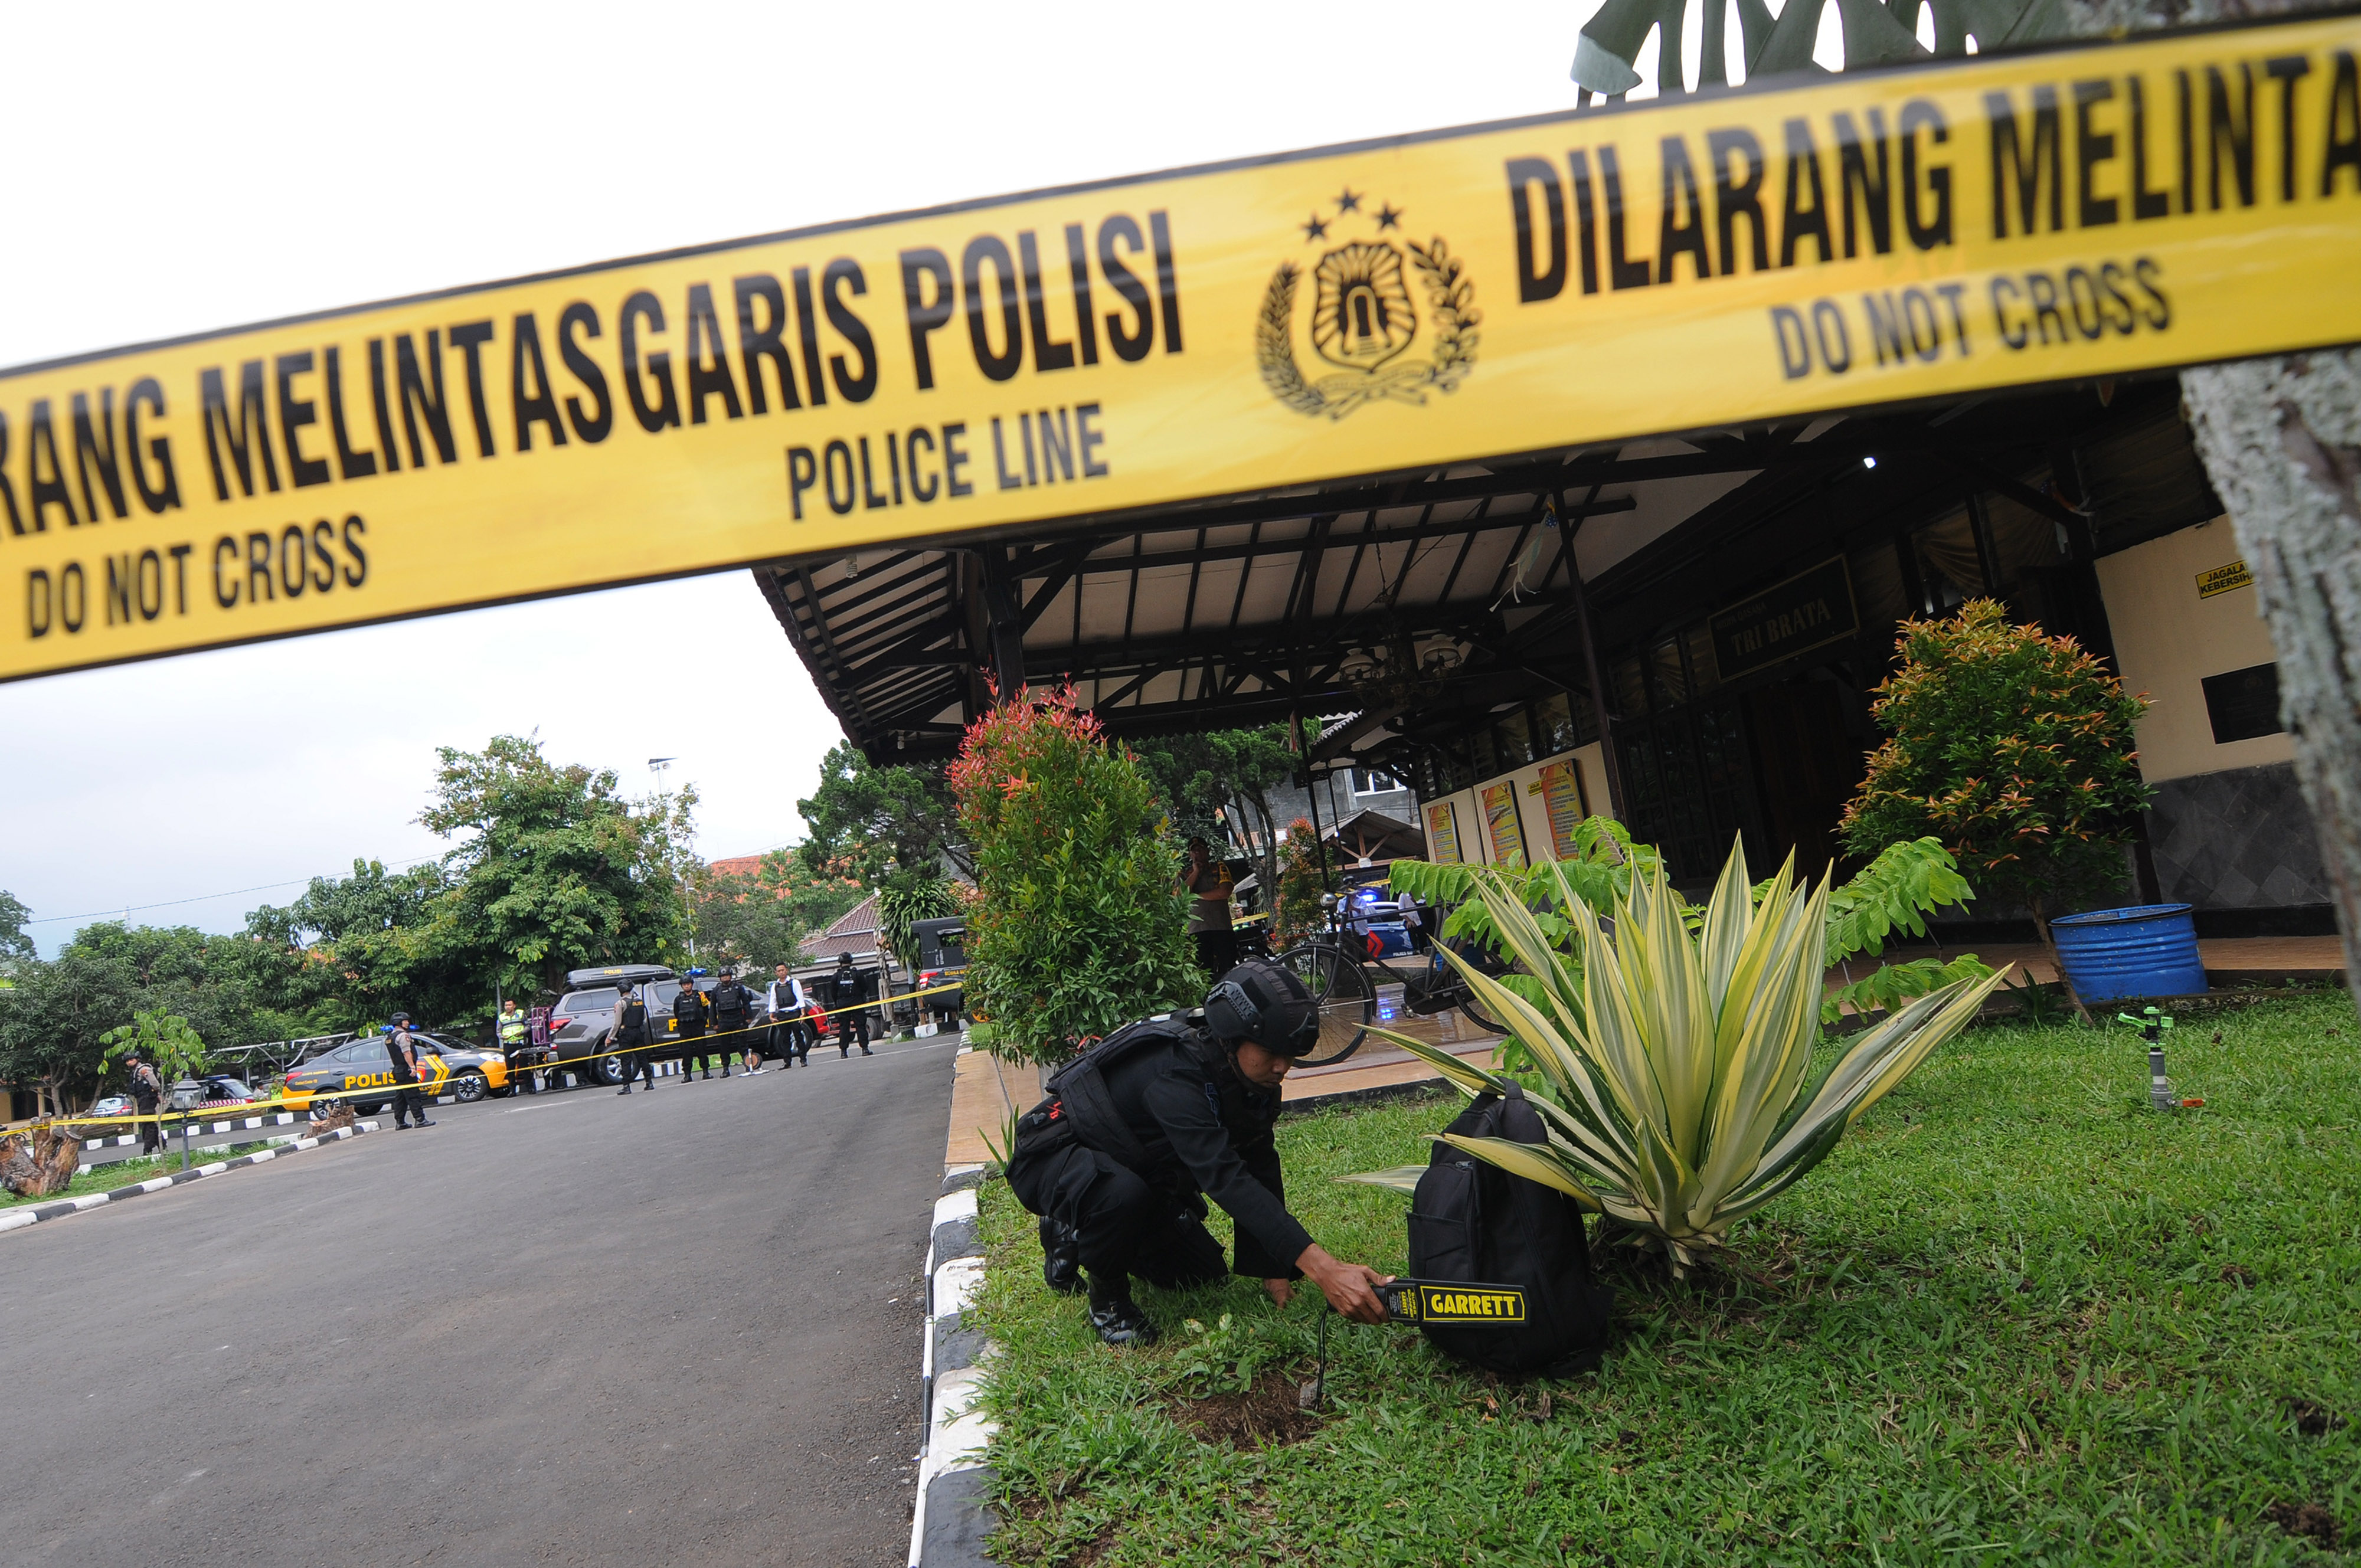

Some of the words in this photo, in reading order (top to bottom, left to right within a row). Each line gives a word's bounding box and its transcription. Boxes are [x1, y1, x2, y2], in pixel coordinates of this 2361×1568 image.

[1503, 97, 1953, 305] DILARANG
[899, 208, 1183, 391] POLISI
[1768, 302, 1850, 382] DO
[1864, 279, 1973, 368] NOT
[1987, 256, 2173, 351] CROSS
[785, 421, 975, 521] POLICE
[991, 401, 1109, 492] LINE
[27, 562, 86, 640] DO
[106, 543, 192, 627] NOT
[212, 513, 368, 609] CROSS
[1731, 624, 1764, 657] TRI
[1766, 597, 1833, 643] BRATA
[2208, 563, 2246, 582] JAGALA
[345, 1071, 397, 1089] POLIS
[1431, 1294, 1516, 1316] GARRETT
